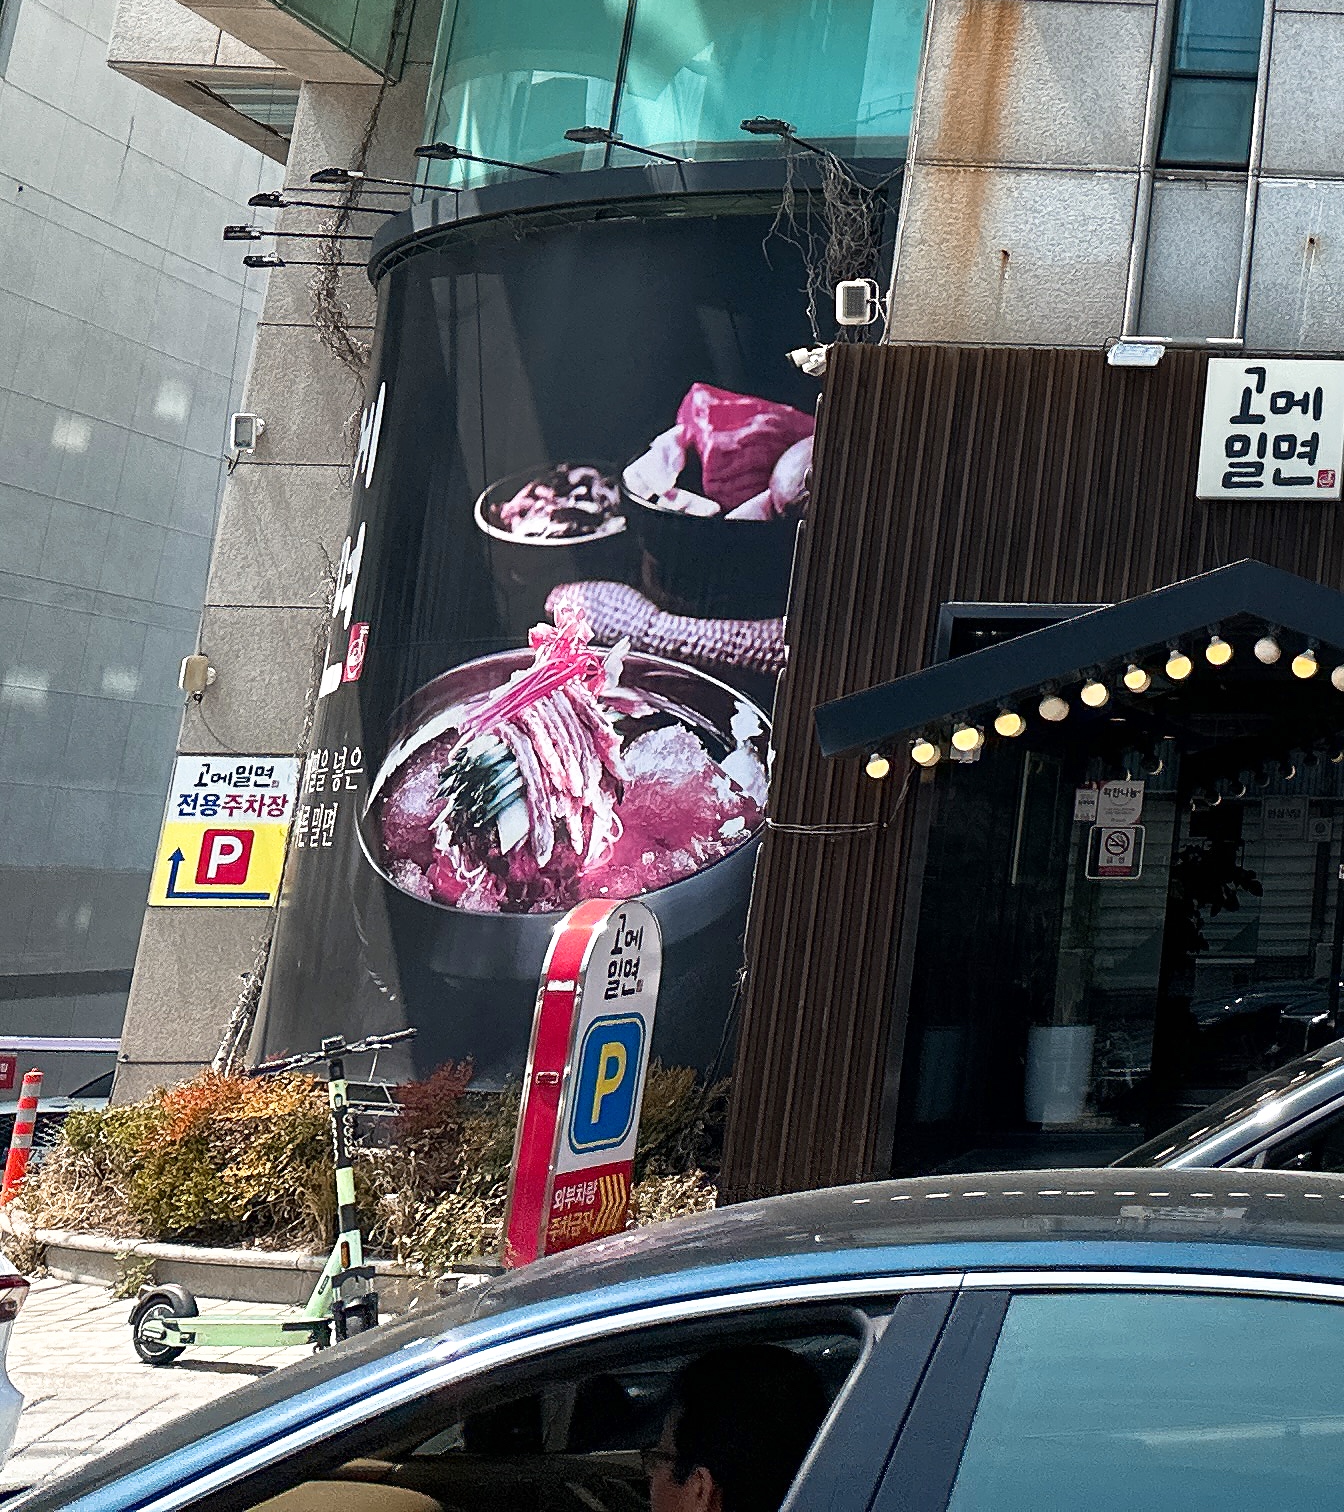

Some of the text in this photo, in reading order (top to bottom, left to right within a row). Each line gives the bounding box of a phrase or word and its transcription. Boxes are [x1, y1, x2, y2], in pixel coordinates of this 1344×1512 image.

[1229, 366, 1323, 424] 고메
[1221, 431, 1320, 489] 밀면
[193, 763, 275, 788] 고메밀면
[177, 793, 289, 818] 전용주차장
[207, 835, 244, 879] P
[610, 913, 644, 956] 고메
[604, 957, 641, 1000] 밀면
[591, 1041, 627, 1124] P
[553, 1179, 599, 1212] 외부차량
